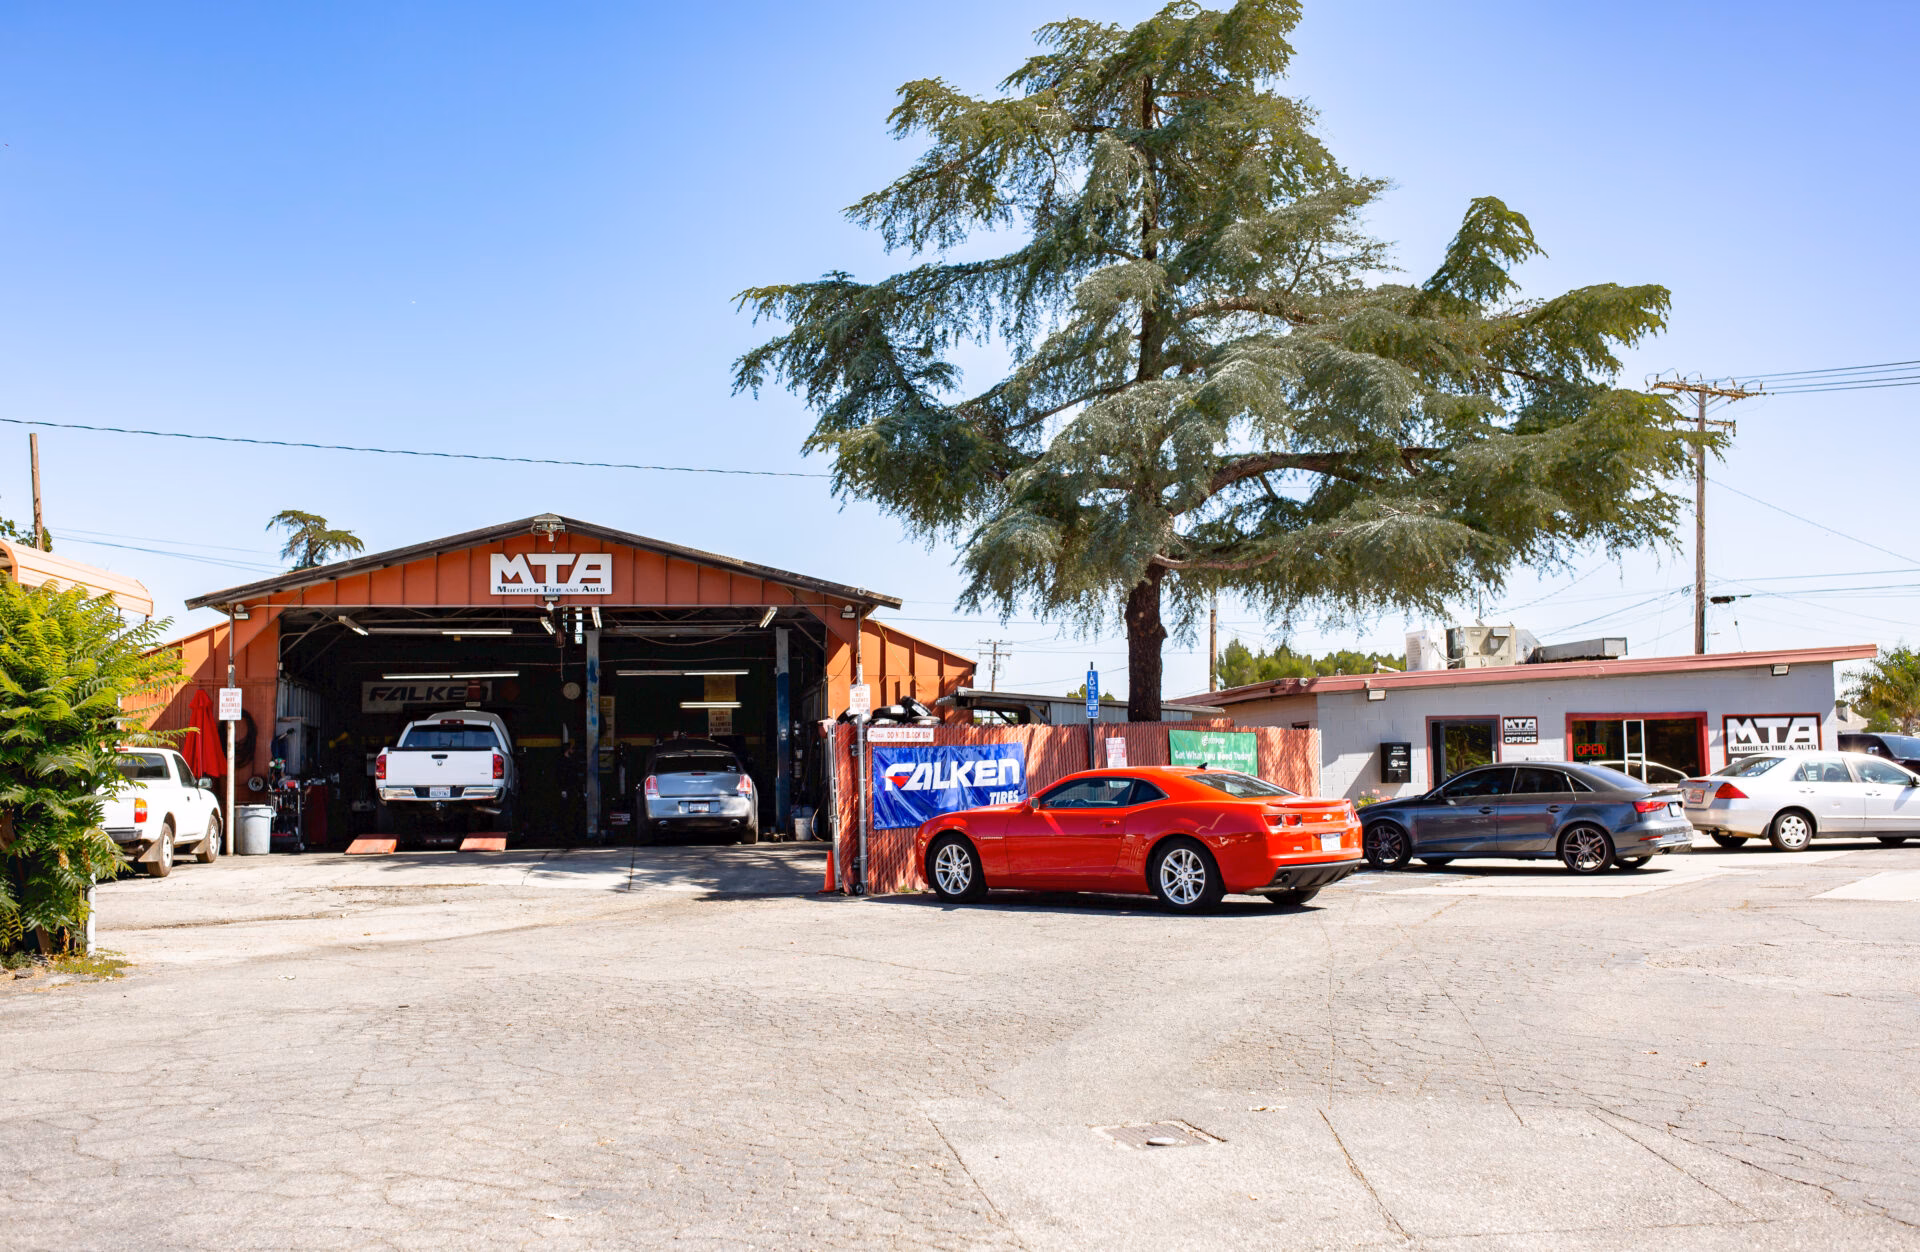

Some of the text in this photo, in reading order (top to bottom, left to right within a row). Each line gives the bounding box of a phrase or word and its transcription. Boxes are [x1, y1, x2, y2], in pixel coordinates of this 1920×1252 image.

[491, 553, 612, 583] MTA
[542, 585, 562, 593] Tire
[582, 585, 606, 593] Auto
[1504, 719, 1536, 729] MTA
[1727, 717, 1818, 743] MTA
[1577, 745, 1606, 755] OPEN
[884, 758, 1020, 791] FALKEN
[989, 790, 1019, 805] TIRES
